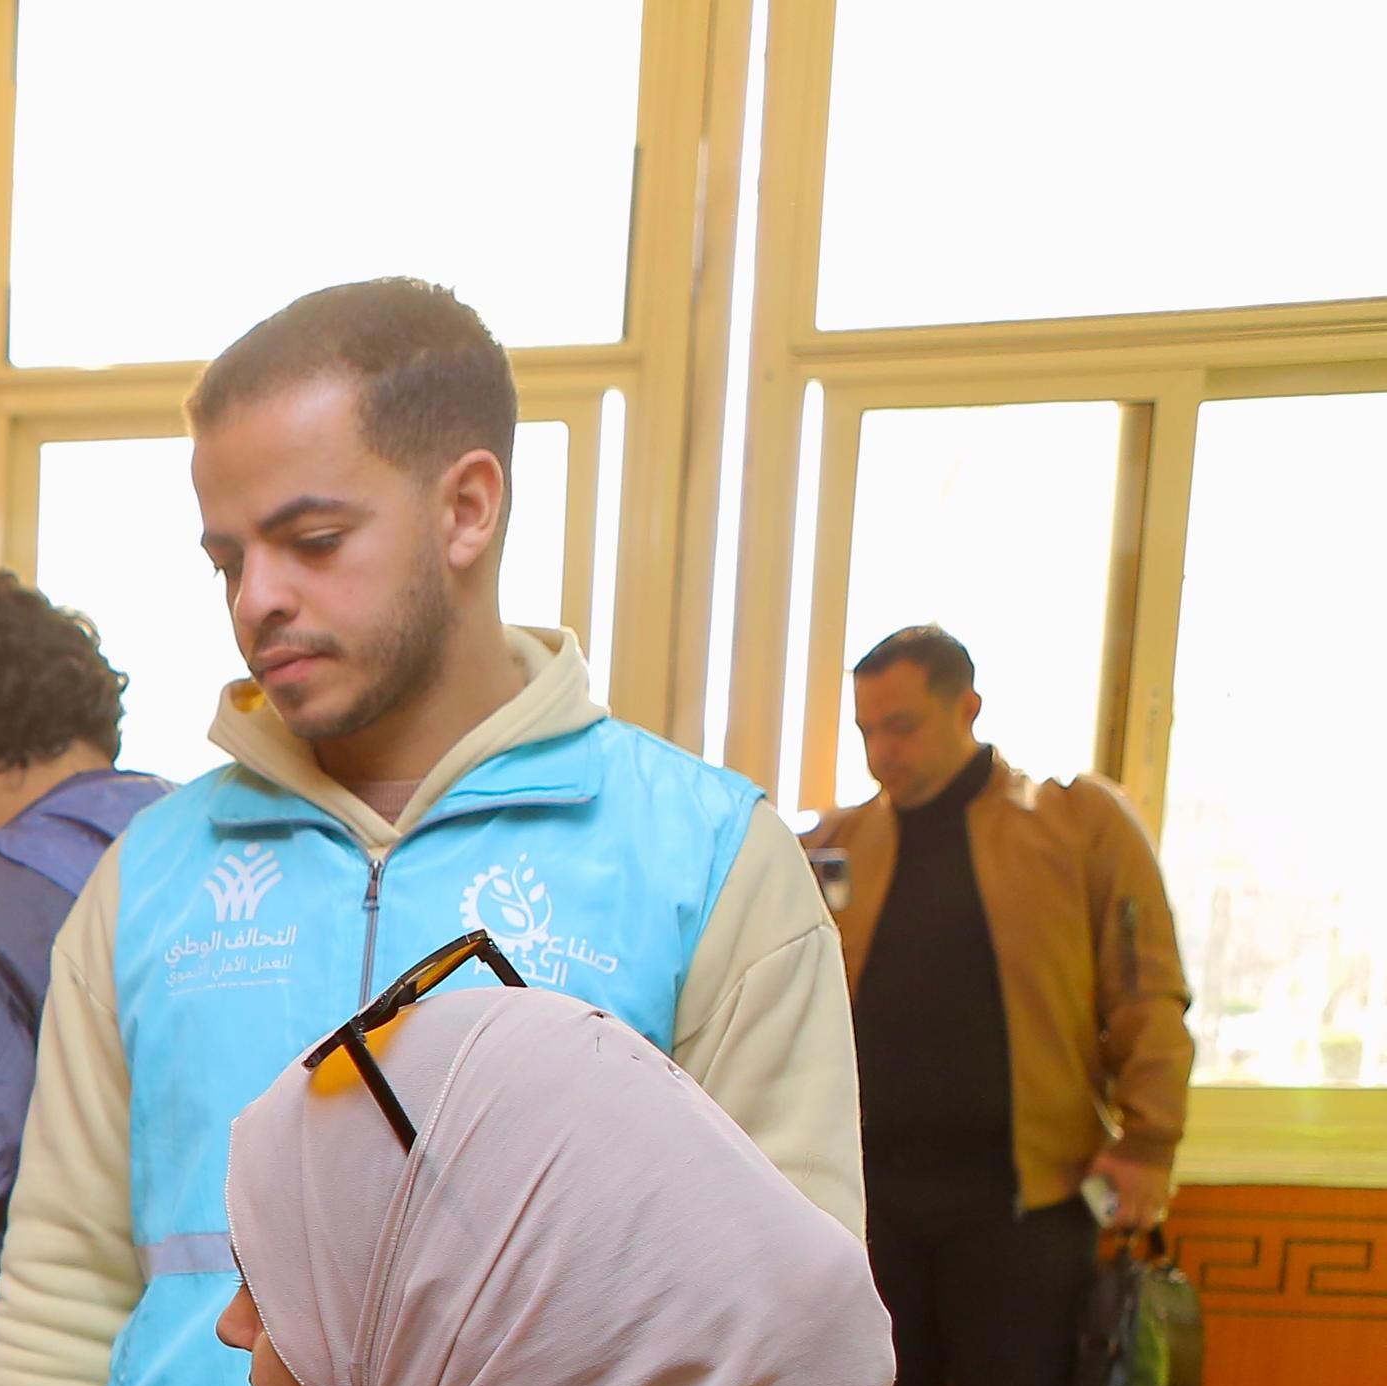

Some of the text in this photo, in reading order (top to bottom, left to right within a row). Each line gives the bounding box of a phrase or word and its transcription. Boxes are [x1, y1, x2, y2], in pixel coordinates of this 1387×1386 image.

[163, 924, 298, 968] التحالف الوطني
[250, 953, 293, 974] للعمل
[540, 936, 620, 974] صناع
